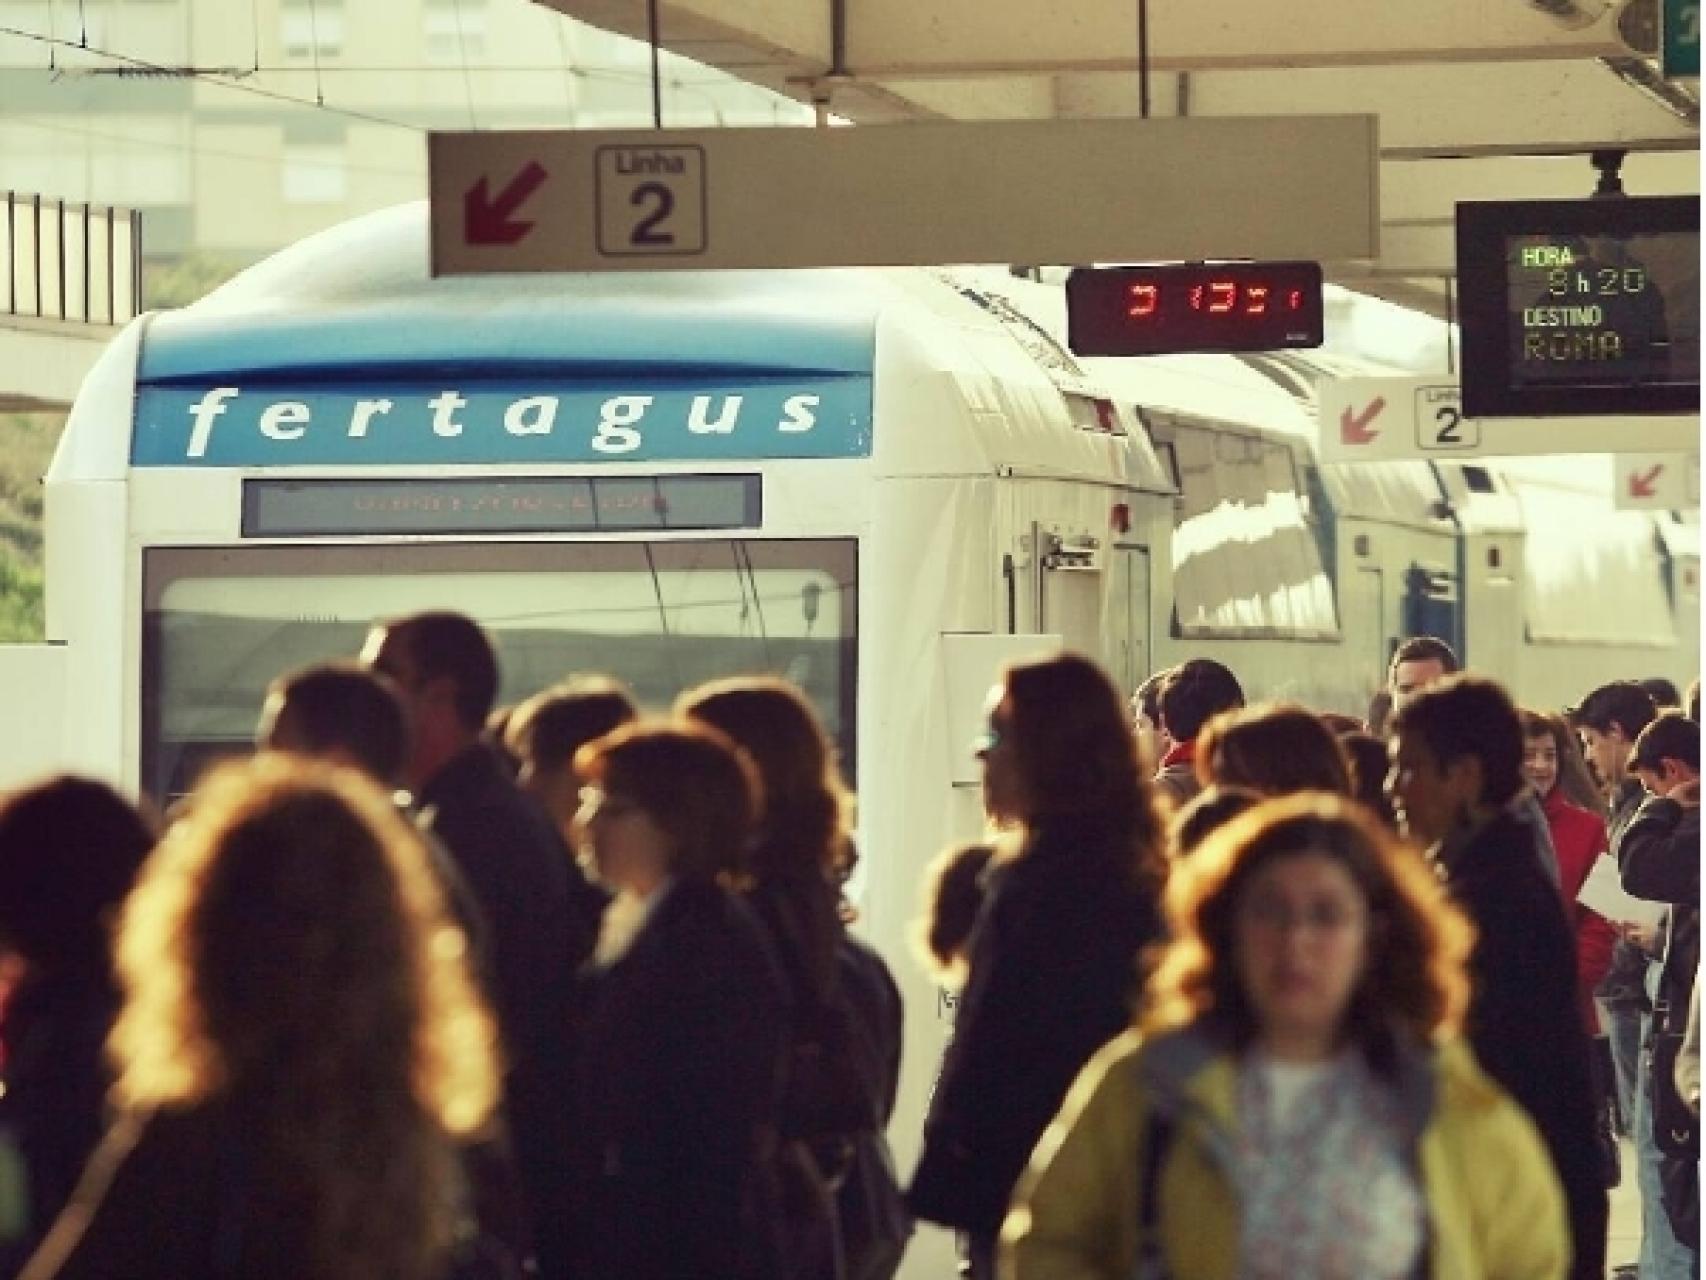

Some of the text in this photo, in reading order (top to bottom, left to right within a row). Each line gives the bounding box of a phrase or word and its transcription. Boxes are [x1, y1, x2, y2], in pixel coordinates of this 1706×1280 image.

[615, 151, 686, 174] Linha
[630, 181, 674, 244] 2
[1523, 247, 1573, 266] HORA
[1524, 305, 1602, 326] DESTINO
[1524, 331, 1622, 360] ROMA
[187, 388, 820, 456] fertagus
[1436, 407, 1462, 442] 2
